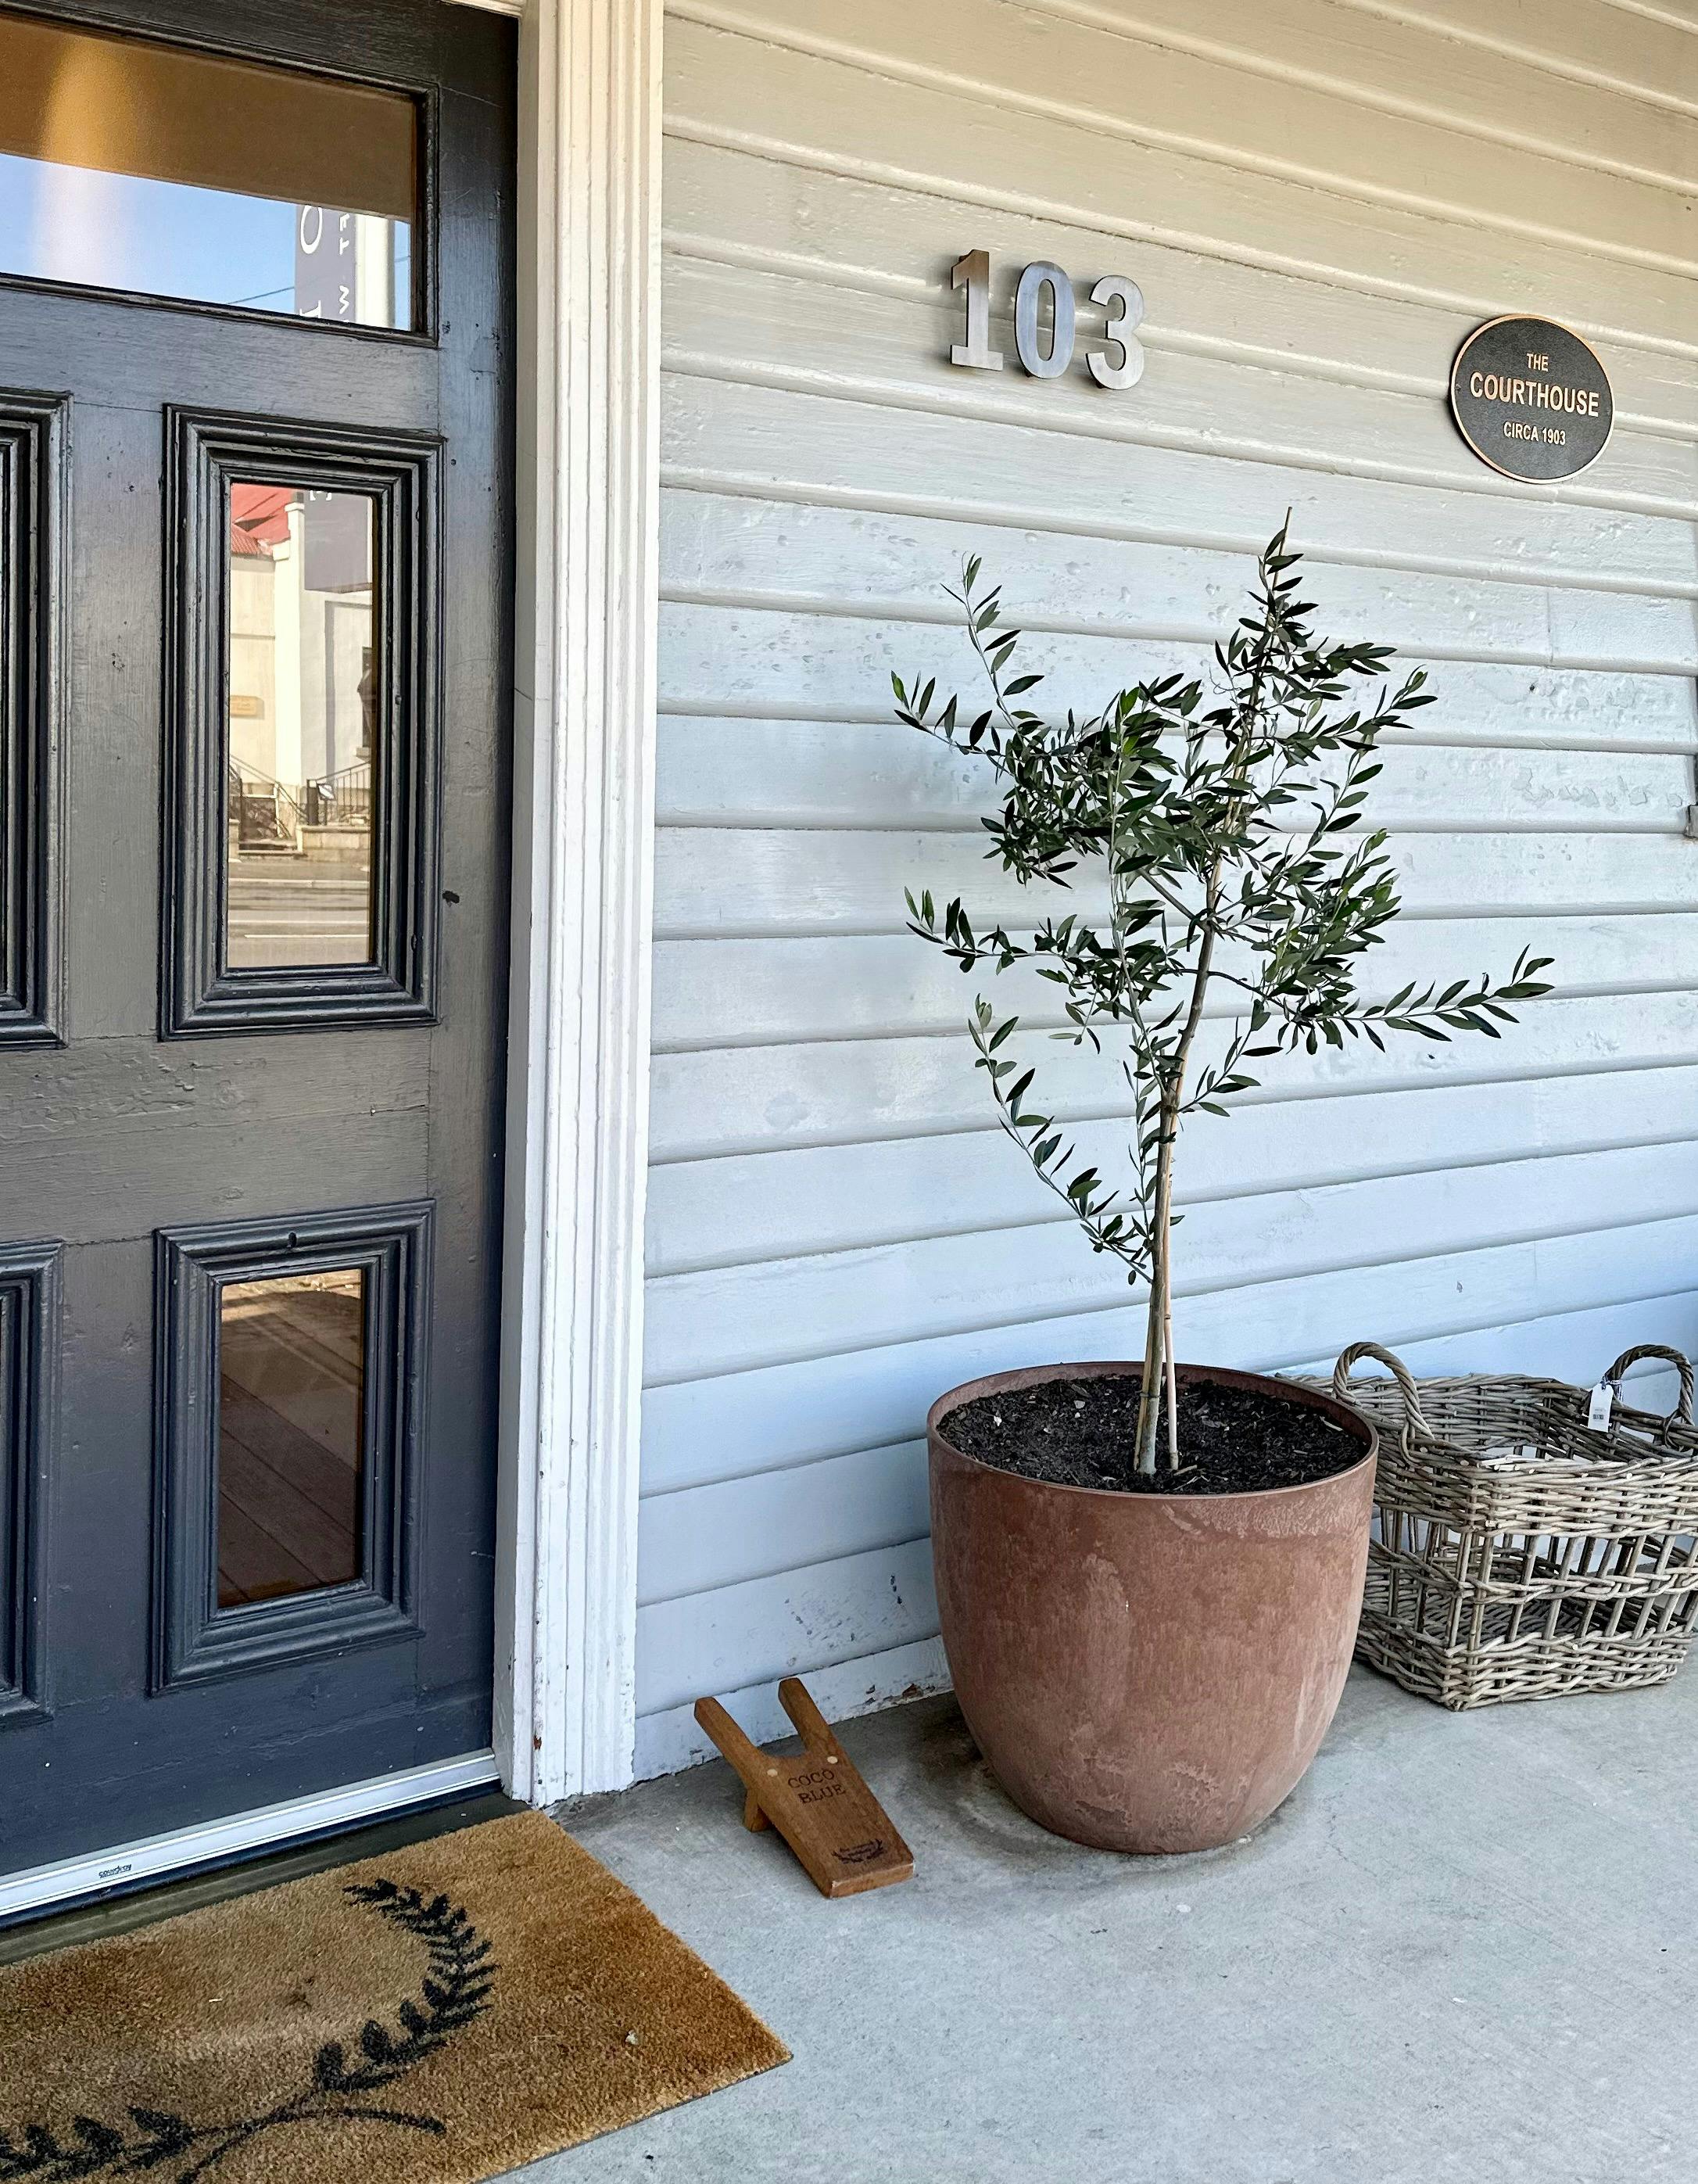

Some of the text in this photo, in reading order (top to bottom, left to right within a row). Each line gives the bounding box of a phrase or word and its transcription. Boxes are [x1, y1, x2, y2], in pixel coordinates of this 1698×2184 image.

[949, 249, 1145, 391] 103
[1526, 353, 1549, 372] THE
[1470, 371, 1599, 418] COURTHOUSE
[1503, 421, 1567, 446] CIRCA 1903
[787, 1769, 835, 1788] COCO
[798, 1784, 847, 1804] BLUE
